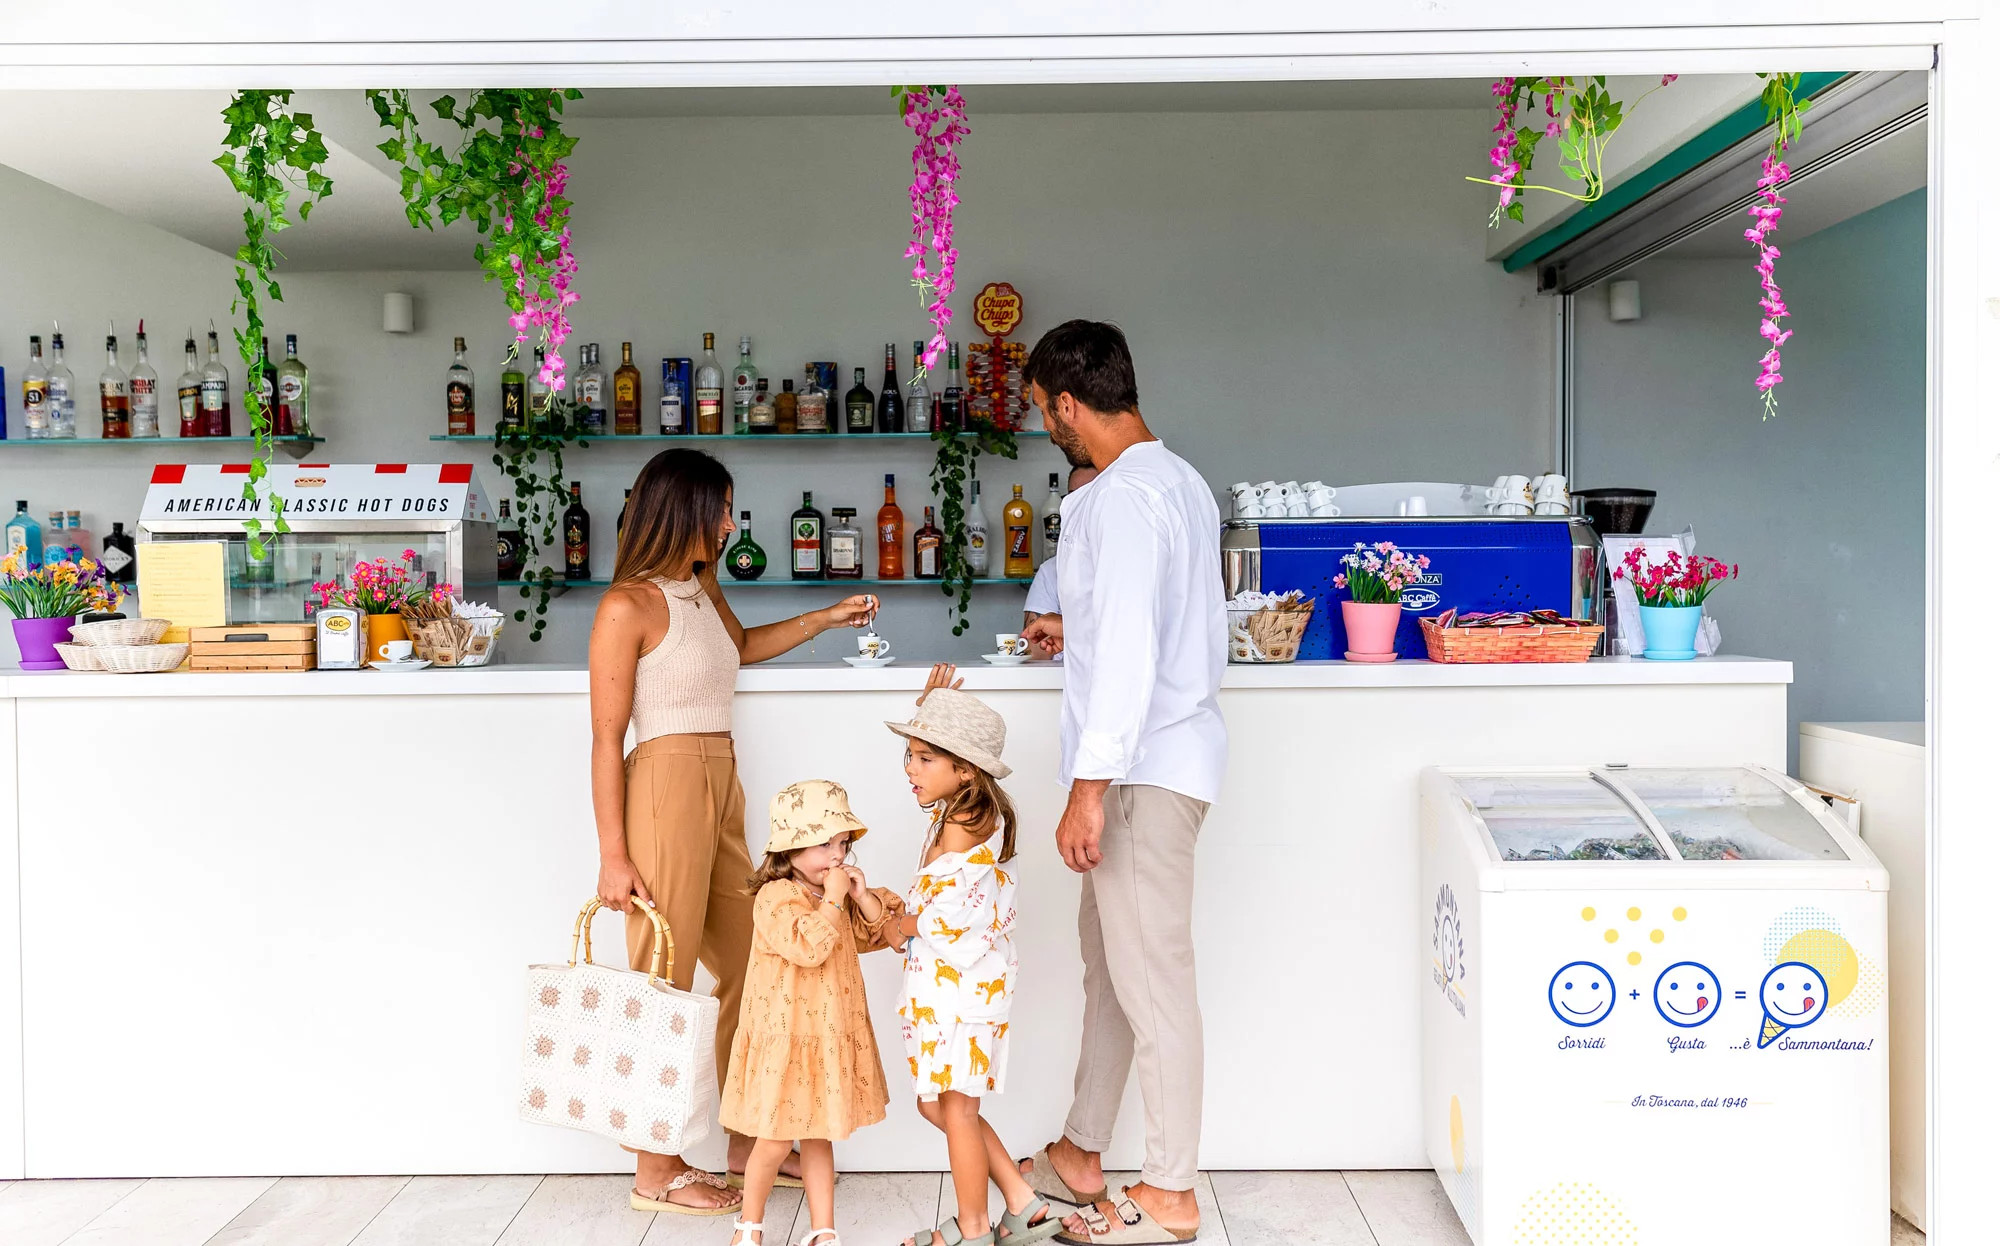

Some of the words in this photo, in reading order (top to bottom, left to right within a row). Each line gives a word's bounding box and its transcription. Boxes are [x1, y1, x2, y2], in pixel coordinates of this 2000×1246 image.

[982, 296, 1016, 310] Chupa
[981, 308, 1014, 327] Chups
[28, 392, 39, 402] 51
[164, 498, 261, 512] AMERICAN
[270, 498, 349, 512] LASSIC
[357, 498, 393, 512] HOT
[402, 498, 449, 512] DOGS
[1433, 883, 1466, 980] SAMMONTANA
[1558, 1035, 1606, 1050] Sorridi
[1667, 1036, 1706, 1053] Gusta
[1778, 1036, 1874, 1051] Sammontana!
[1631, 1095, 1647, 1107] In
[1649, 1095, 1699, 1108] Toscana,
[1701, 1097, 1719, 1107] dal
[1722, 1097, 1748, 1108] 1946
